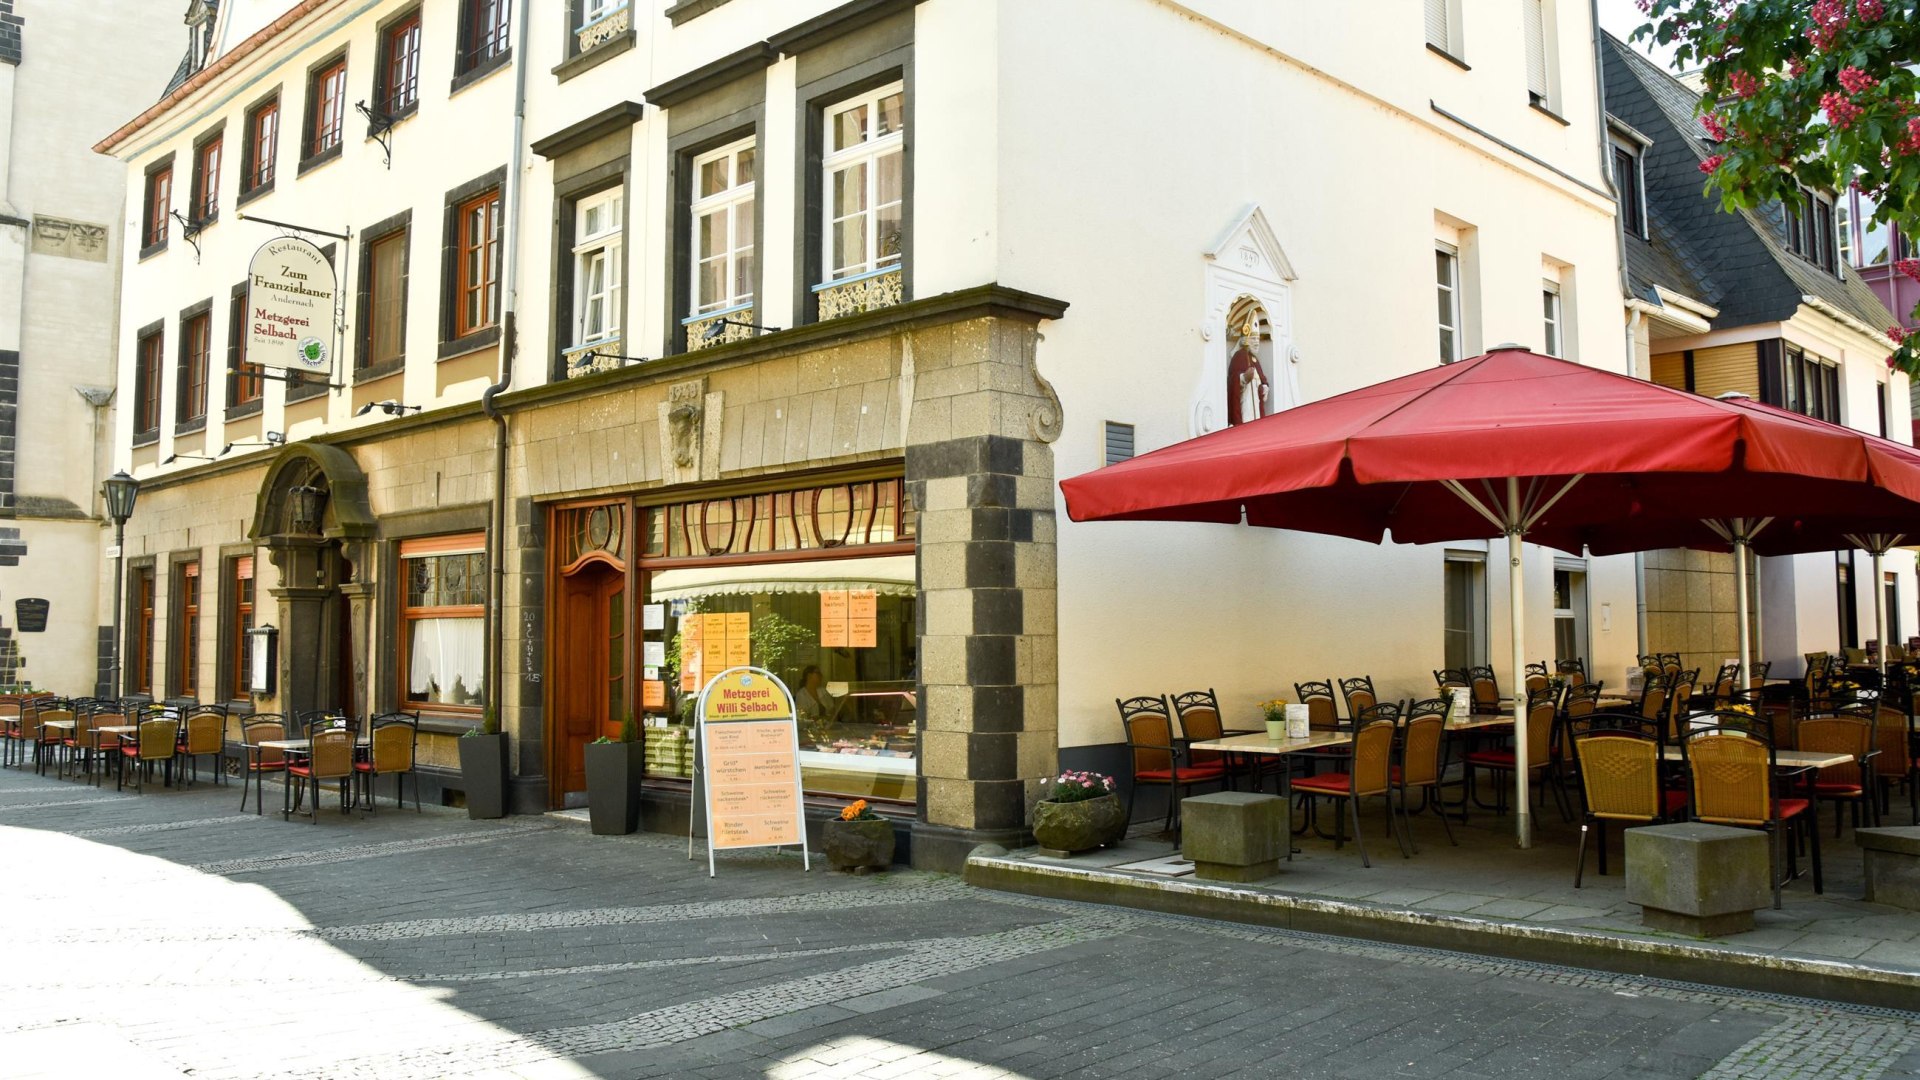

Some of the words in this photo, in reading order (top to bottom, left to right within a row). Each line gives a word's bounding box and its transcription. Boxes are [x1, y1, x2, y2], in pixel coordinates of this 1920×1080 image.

[268, 243, 322, 265] Restaurant
[281, 265, 308, 280] Zum
[254, 274, 332, 300] Franziskaner
[271, 294, 314, 308] Andernach
[255, 308, 310, 327] Metzgerei
[254, 323, 297, 340] Selbach
[723, 688, 770, 701] Metzgerei
[717, 703, 738, 713] Willi
[740, 701, 779, 713] Selbach
